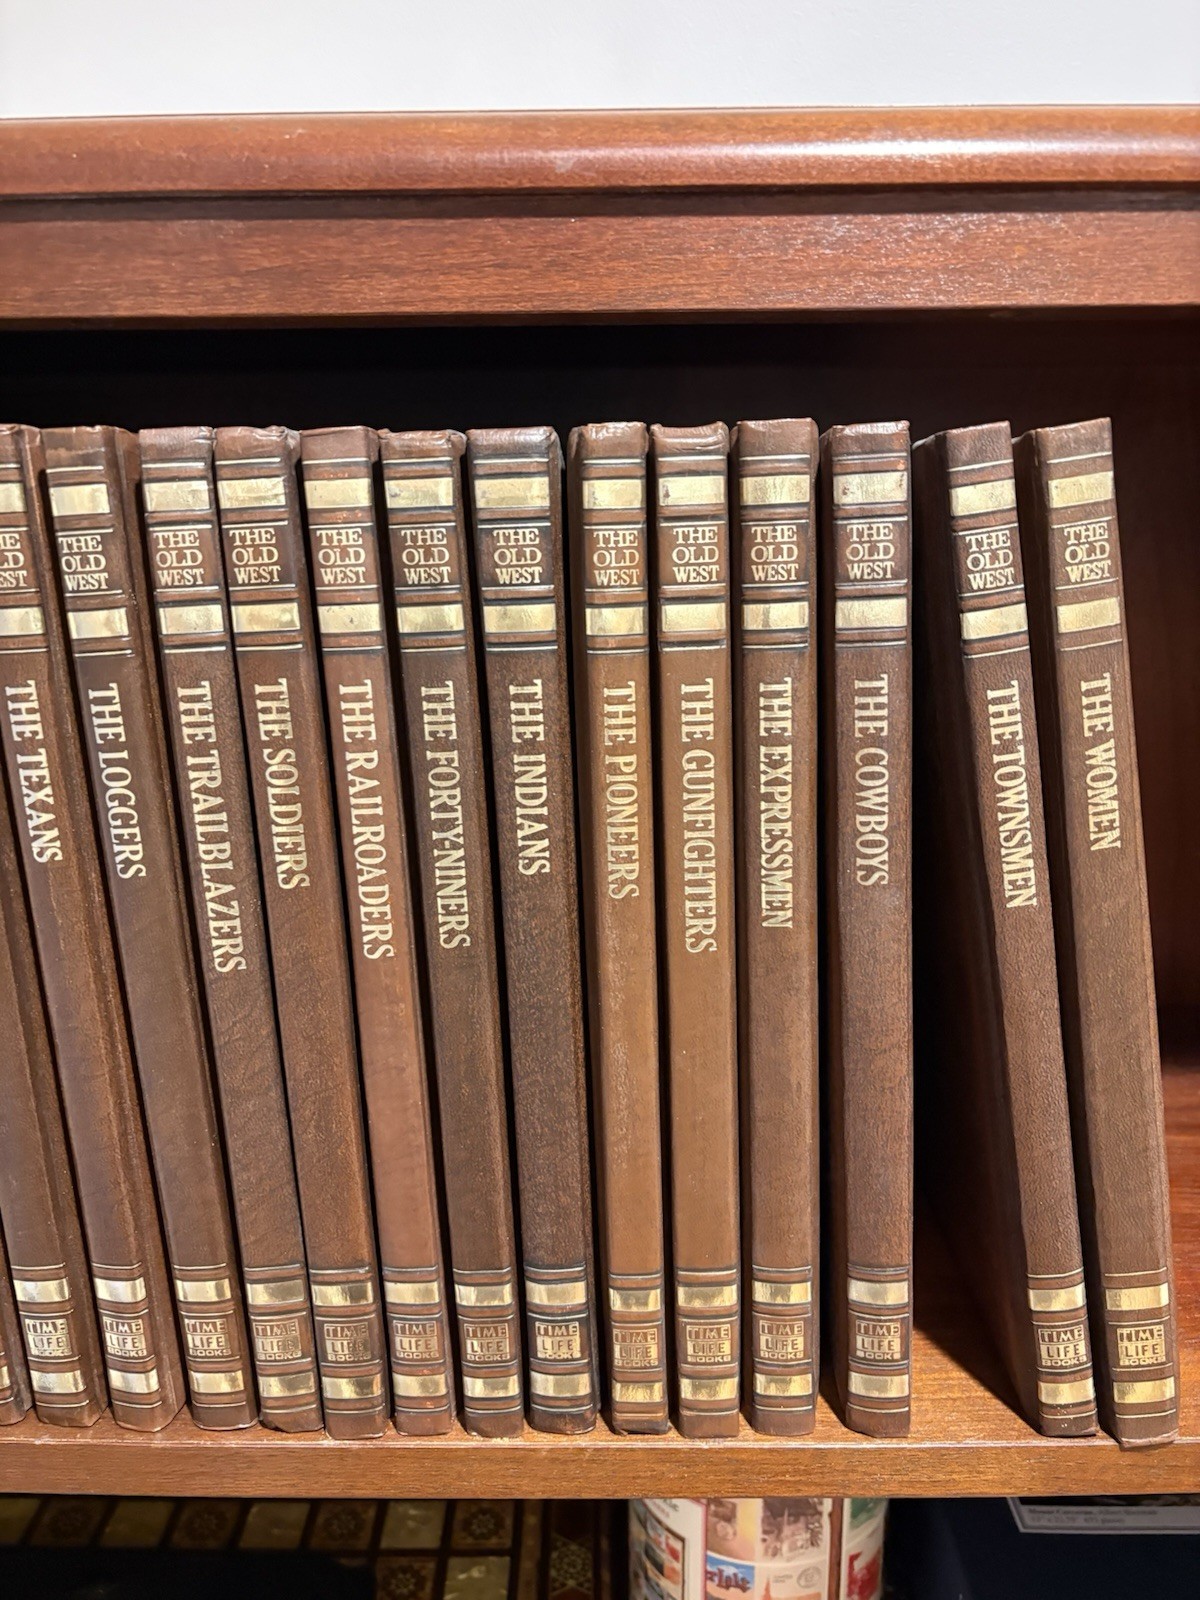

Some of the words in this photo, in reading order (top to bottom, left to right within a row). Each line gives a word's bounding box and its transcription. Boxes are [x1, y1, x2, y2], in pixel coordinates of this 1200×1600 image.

[153, 530, 199, 548] THE
[230, 528, 276, 546] THE
[316, 528, 362, 546] THE
[401, 529, 447, 546] THE
[493, 528, 539, 546] THE
[593, 530, 638, 548] THE
[672, 527, 718, 544] THE
[751, 525, 796, 543] THE
[847, 524, 893, 541] THE
[966, 530, 1011, 552] THE
[1064, 522, 1108, 545] THE
[59, 535, 102, 553] THE
[846, 543, 895, 561] OLD
[1064, 542, 1110, 563] OLD
[156, 548, 203, 567] OLD
[232, 547, 278, 565] OLD
[318, 547, 365, 566] OLD
[402, 547, 450, 565] OLD
[494, 547, 542, 565] OLD
[593, 549, 639, 567] OLD
[672, 546, 719, 564] OLD
[751, 544, 798, 563] OLD
[966, 550, 1013, 571] OLD
[61, 555, 106, 571] OLD
[751, 563, 799, 581] WEST
[847, 561, 893, 579] WEST
[1066, 560, 1111, 582] WEST
[0, 570, 27, 588] EST
[64, 573, 108, 591] WEST
[157, 568, 205, 586] WEST
[234, 565, 280, 583] WEST
[320, 567, 366, 585] WEST
[403, 566, 451, 584] WEST
[495, 566, 543, 584] WEST
[593, 569, 639, 586] WEST
[672, 565, 719, 582] WEST
[968, 568, 1015, 590] WEST
[5, 680, 44, 742] THE
[88, 682, 126, 744] THE
[177, 680, 217, 745] THE
[254, 678, 293, 741] THE
[339, 679, 376, 743] THE
[421, 680, 457, 742] THE
[509, 678, 545, 743] THE
[603, 681, 638, 746] THE
[681, 678, 714, 742] THE
[759, 677, 792, 737] THE
[854, 674, 888, 738] THE
[987, 679, 1025, 746] THE
[1080, 672, 1115, 738] THE
[1084, 739, 1121, 852] WOMEN
[16, 749, 63, 864] TEXANS
[98, 749, 147, 879] LOGGERS
[513, 754, 551, 876] INDIANS
[262, 748, 310, 890] SOLDIERS
[854, 747, 890, 887] COWBOYS
[605, 754, 639, 900] PIONEERS
[992, 746, 1038, 909] TOWNSMEN
[759, 744, 793, 929] EXPRESSMEN
[345, 749, 394, 960] RAILROADERS
[426, 749, 471, 949] FORTY-NINERS
[681, 749, 718, 953] GUNFIGHTERS
[186, 749, 247, 973] TRAILBLAZERS
[28, 1320, 66, 1333] TIME
[105, 1319, 141, 1333] TIME
[186, 1320, 225, 1333] TIME
[255, 1323, 297, 1336] TIME
[395, 1322, 435, 1335] TIME
[467, 1325, 506, 1337] TIME
[538, 1324, 578, 1336] TIME
[689, 1326, 729, 1338] TIME
[761, 1323, 802, 1334] TIME
[858, 1323, 899, 1336] TIME
[1041, 1327, 1084, 1342] TIME
[1120, 1328, 1162, 1342] TIME
[34, 1337, 63, 1348] LIFE
[110, 1336, 139, 1348] LIFE
[192, 1336, 224, 1348] LIFE
[262, 1339, 294, 1351] LIFE
[400, 1339, 432, 1350] LIFE
[543, 1338, 574, 1350] LIFE
[616, 1331, 655, 1343] TIME
[766, 1339, 798, 1350] LIFE
[862, 1339, 895, 1350] LIFE
[471, 1341, 504, 1353] LIFE
[620, 1346, 652, 1358] LIFE
[693, 1342, 725, 1353] LIFE
[1047, 1344, 1079, 1357] LIFE
[1126, 1343, 1159, 1357] LIFE
[467, 1353, 510, 1361] BOOKS
